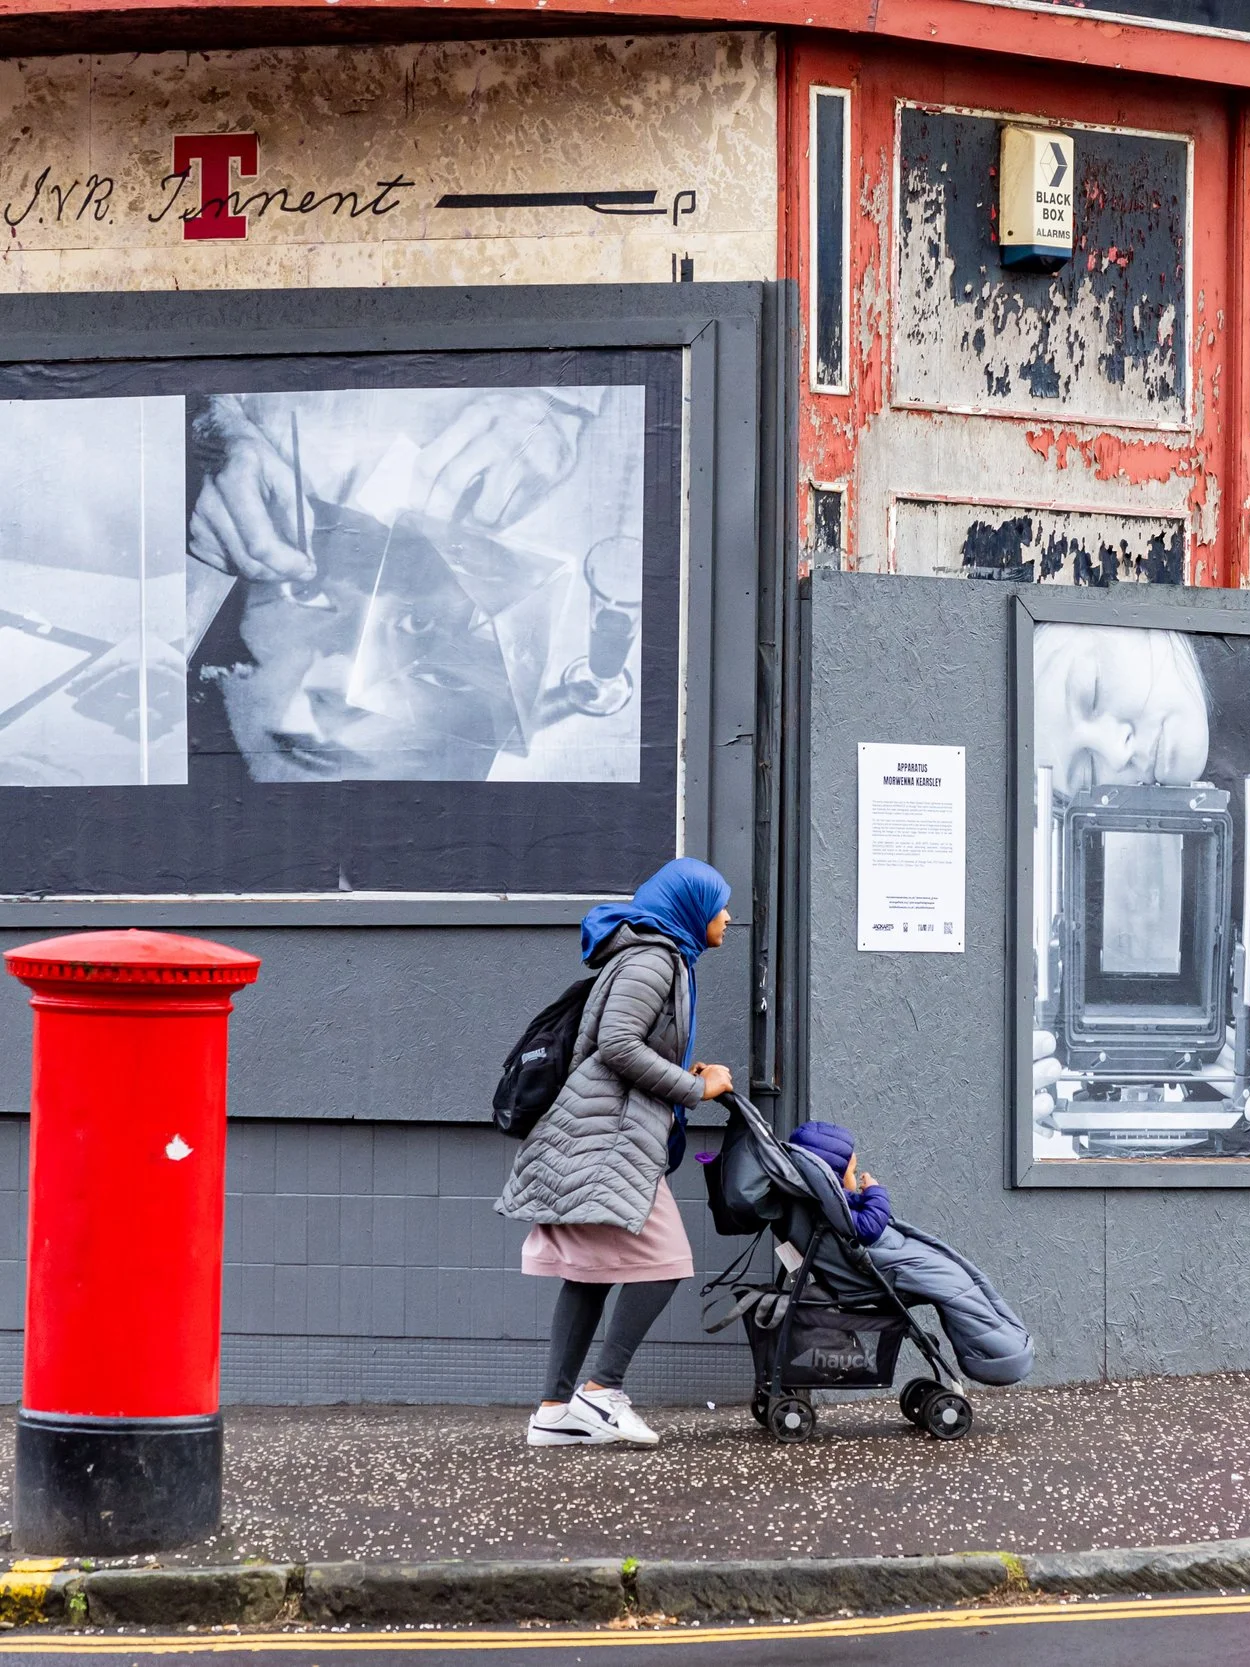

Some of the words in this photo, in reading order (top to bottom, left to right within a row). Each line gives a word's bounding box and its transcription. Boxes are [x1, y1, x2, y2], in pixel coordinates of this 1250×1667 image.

[148, 166, 415, 222] Tennent
[1036, 191, 1071, 206] BLACK
[1043, 208, 1064, 221] BOX
[1036, 228, 1071, 240] ALARMS
[897, 763, 928, 773] APPARATUS
[883, 776, 914, 786] MORWENNA
[915, 777, 942, 787] KEARSLEY
[814, 1348, 879, 1374] hauck
